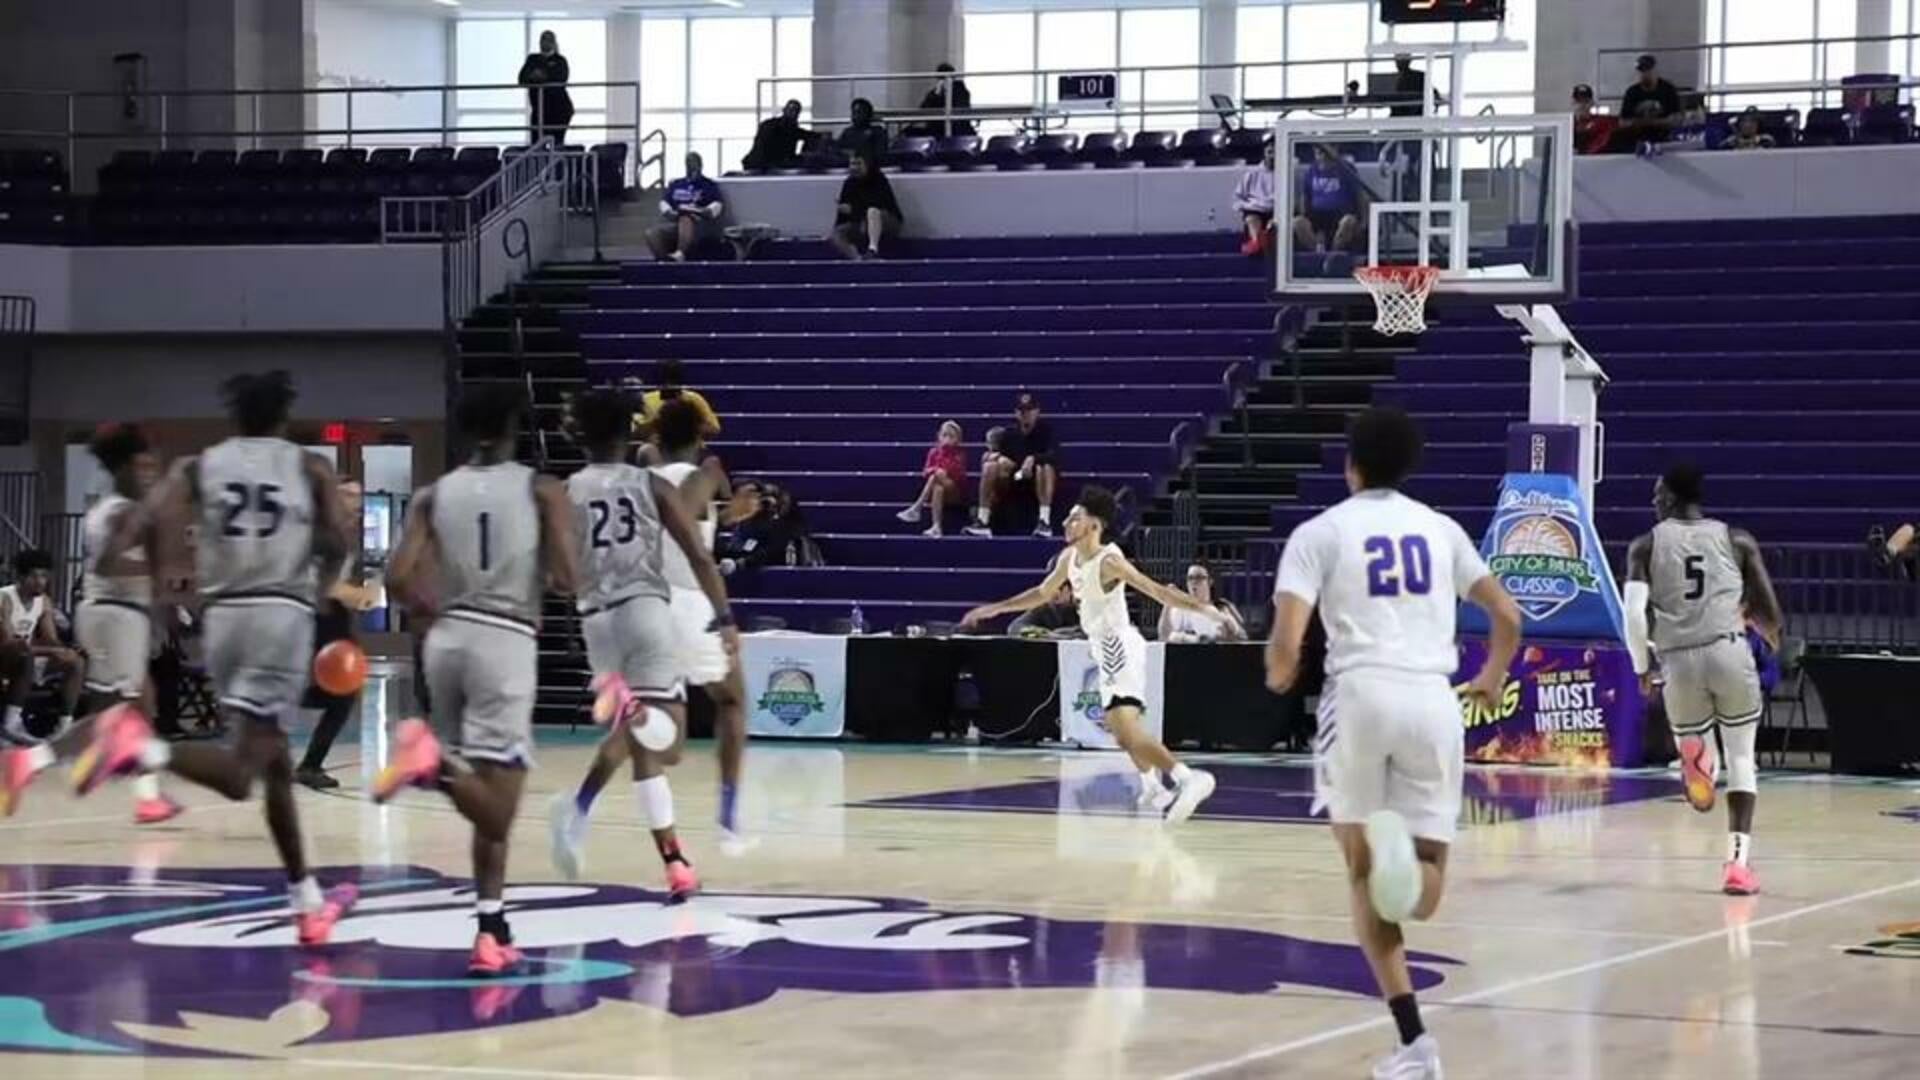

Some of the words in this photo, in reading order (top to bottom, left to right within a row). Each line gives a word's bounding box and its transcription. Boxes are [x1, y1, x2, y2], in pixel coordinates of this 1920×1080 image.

[1080, 78, 1104, 95] 101
[223, 482, 285, 537] 25
[590, 497, 637, 548] 23
[478, 512, 490, 571] 1
[1364, 534, 1432, 597] 20
[1490, 558, 1523, 575] CITY
[1525, 556, 1545, 572] OF
[1684, 555, 1705, 600] 5
[1505, 576, 1568, 594] CLASSIC
[1537, 682, 1596, 711] MOST
[1534, 708, 1605, 733] INTENSE
[1552, 731, 1605, 747] SNACKS
